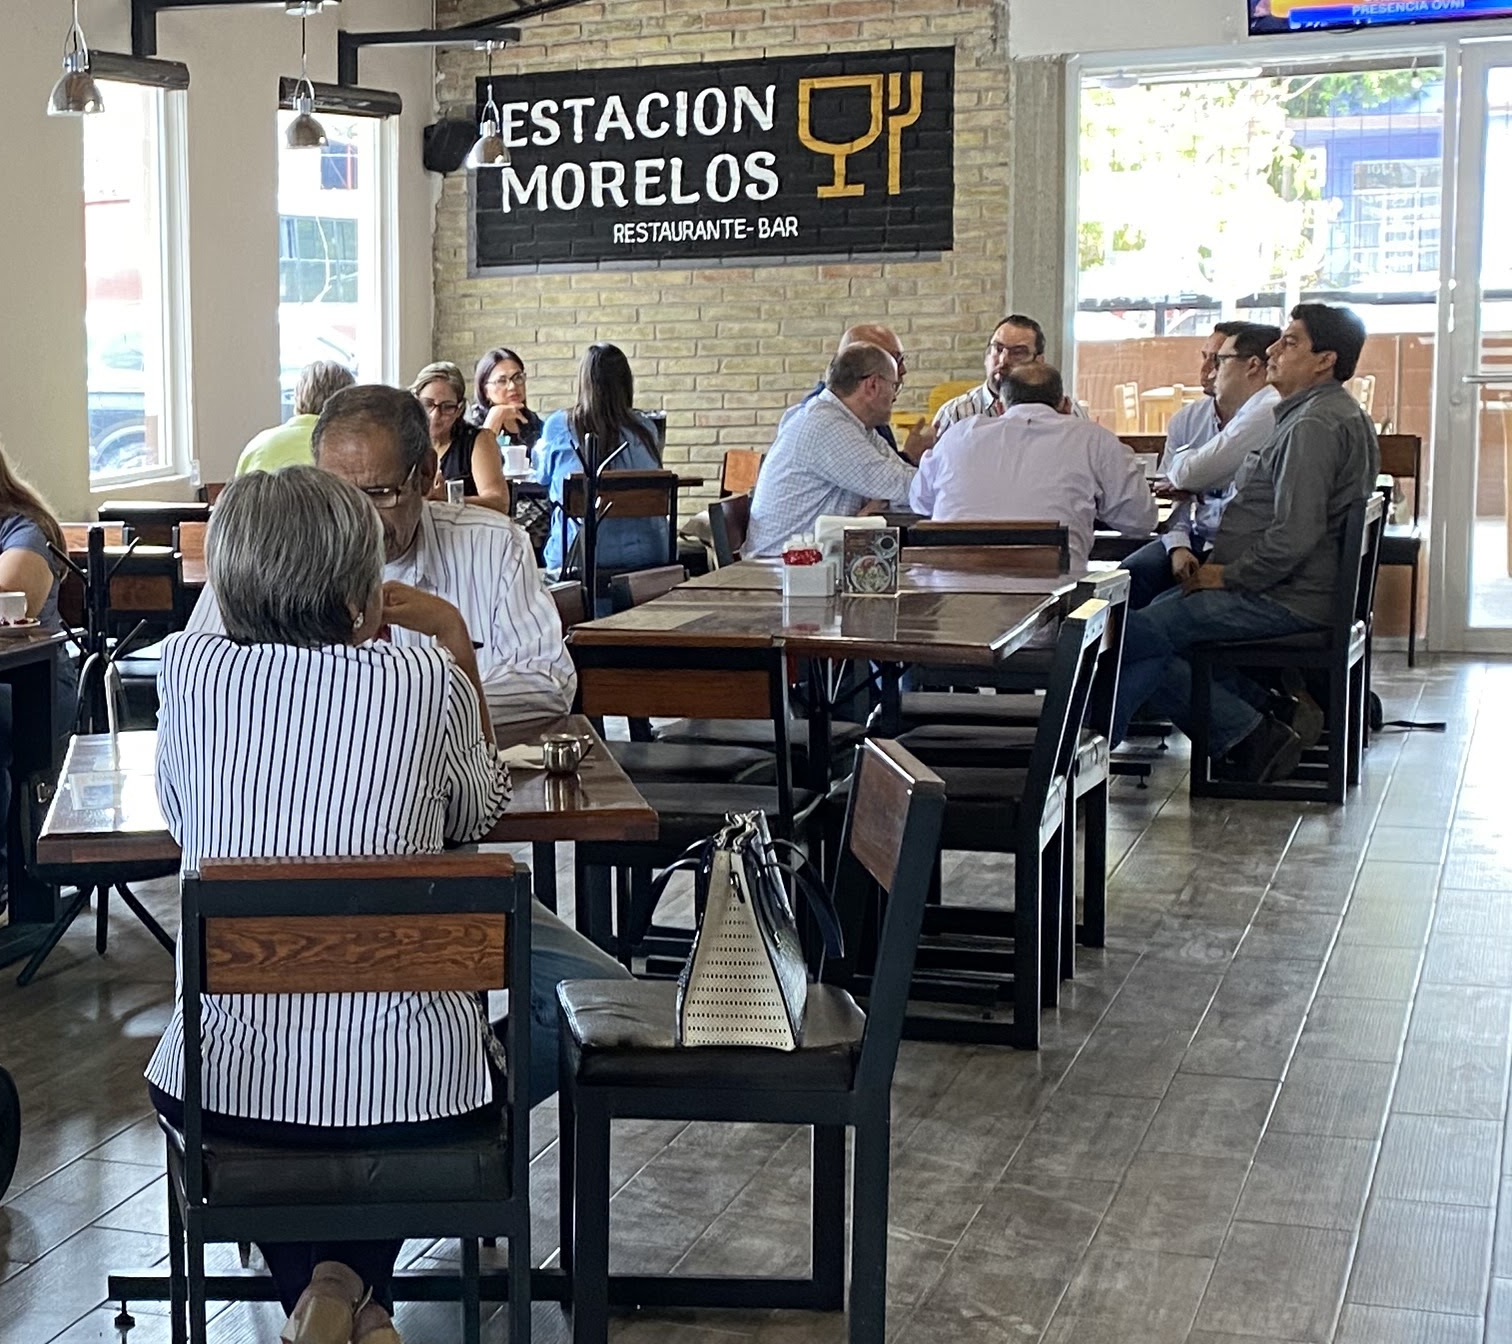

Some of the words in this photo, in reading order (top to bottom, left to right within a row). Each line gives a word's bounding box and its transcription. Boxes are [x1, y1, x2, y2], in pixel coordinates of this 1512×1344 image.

[1352, 1, 1429, 16] PRESENCIA
[1431, 0, 1465, 10] OVNI
[502, 85, 776, 147] ESTACION
[501, 151, 779, 213] MORELOS
